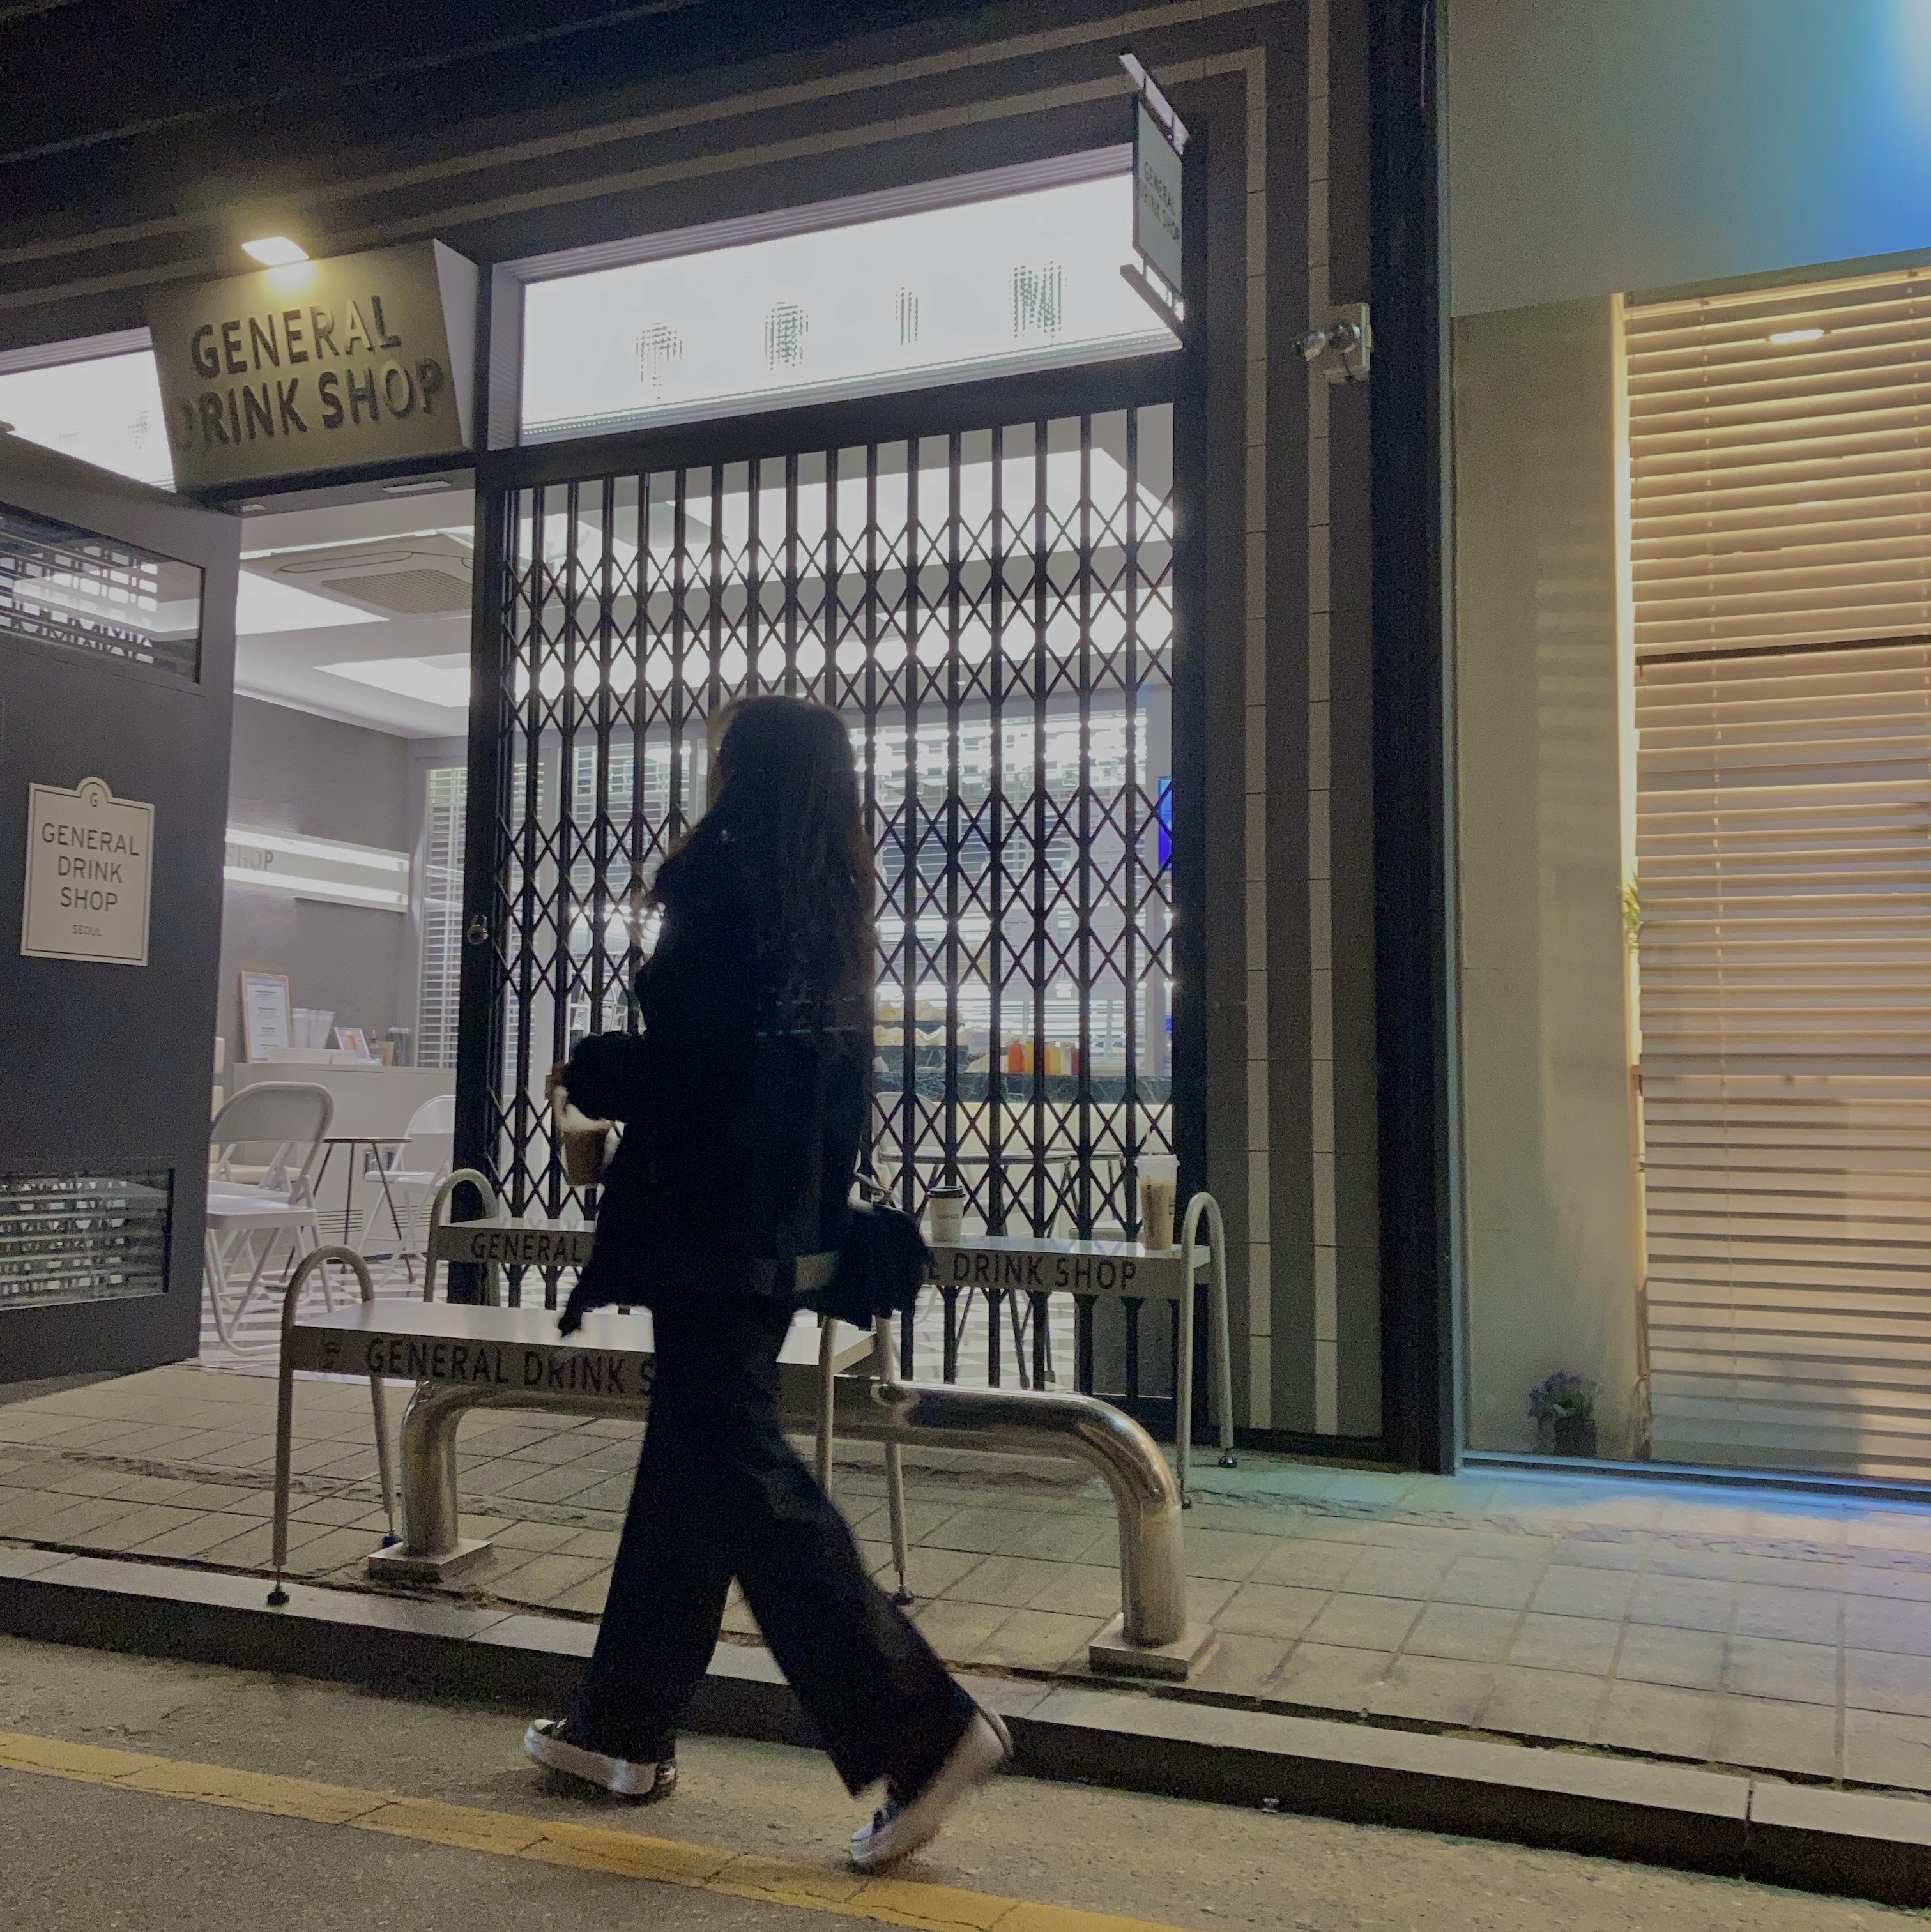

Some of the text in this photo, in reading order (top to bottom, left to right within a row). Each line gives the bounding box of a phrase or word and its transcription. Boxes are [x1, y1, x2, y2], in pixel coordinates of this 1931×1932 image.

[192, 294, 402, 380] GENERAL
[319, 356, 445, 430] SHOP
[42, 822, 140, 856] GENERAL
[58, 855, 123, 883] DRINK
[60, 886, 118, 911] SHOP
[471, 1231, 583, 1263] GENERAL
[953, 1252, 1044, 1287] DRINK
[1054, 1256, 1136, 1291] SHOP
[366, 1337, 509, 1384] GENERAL
